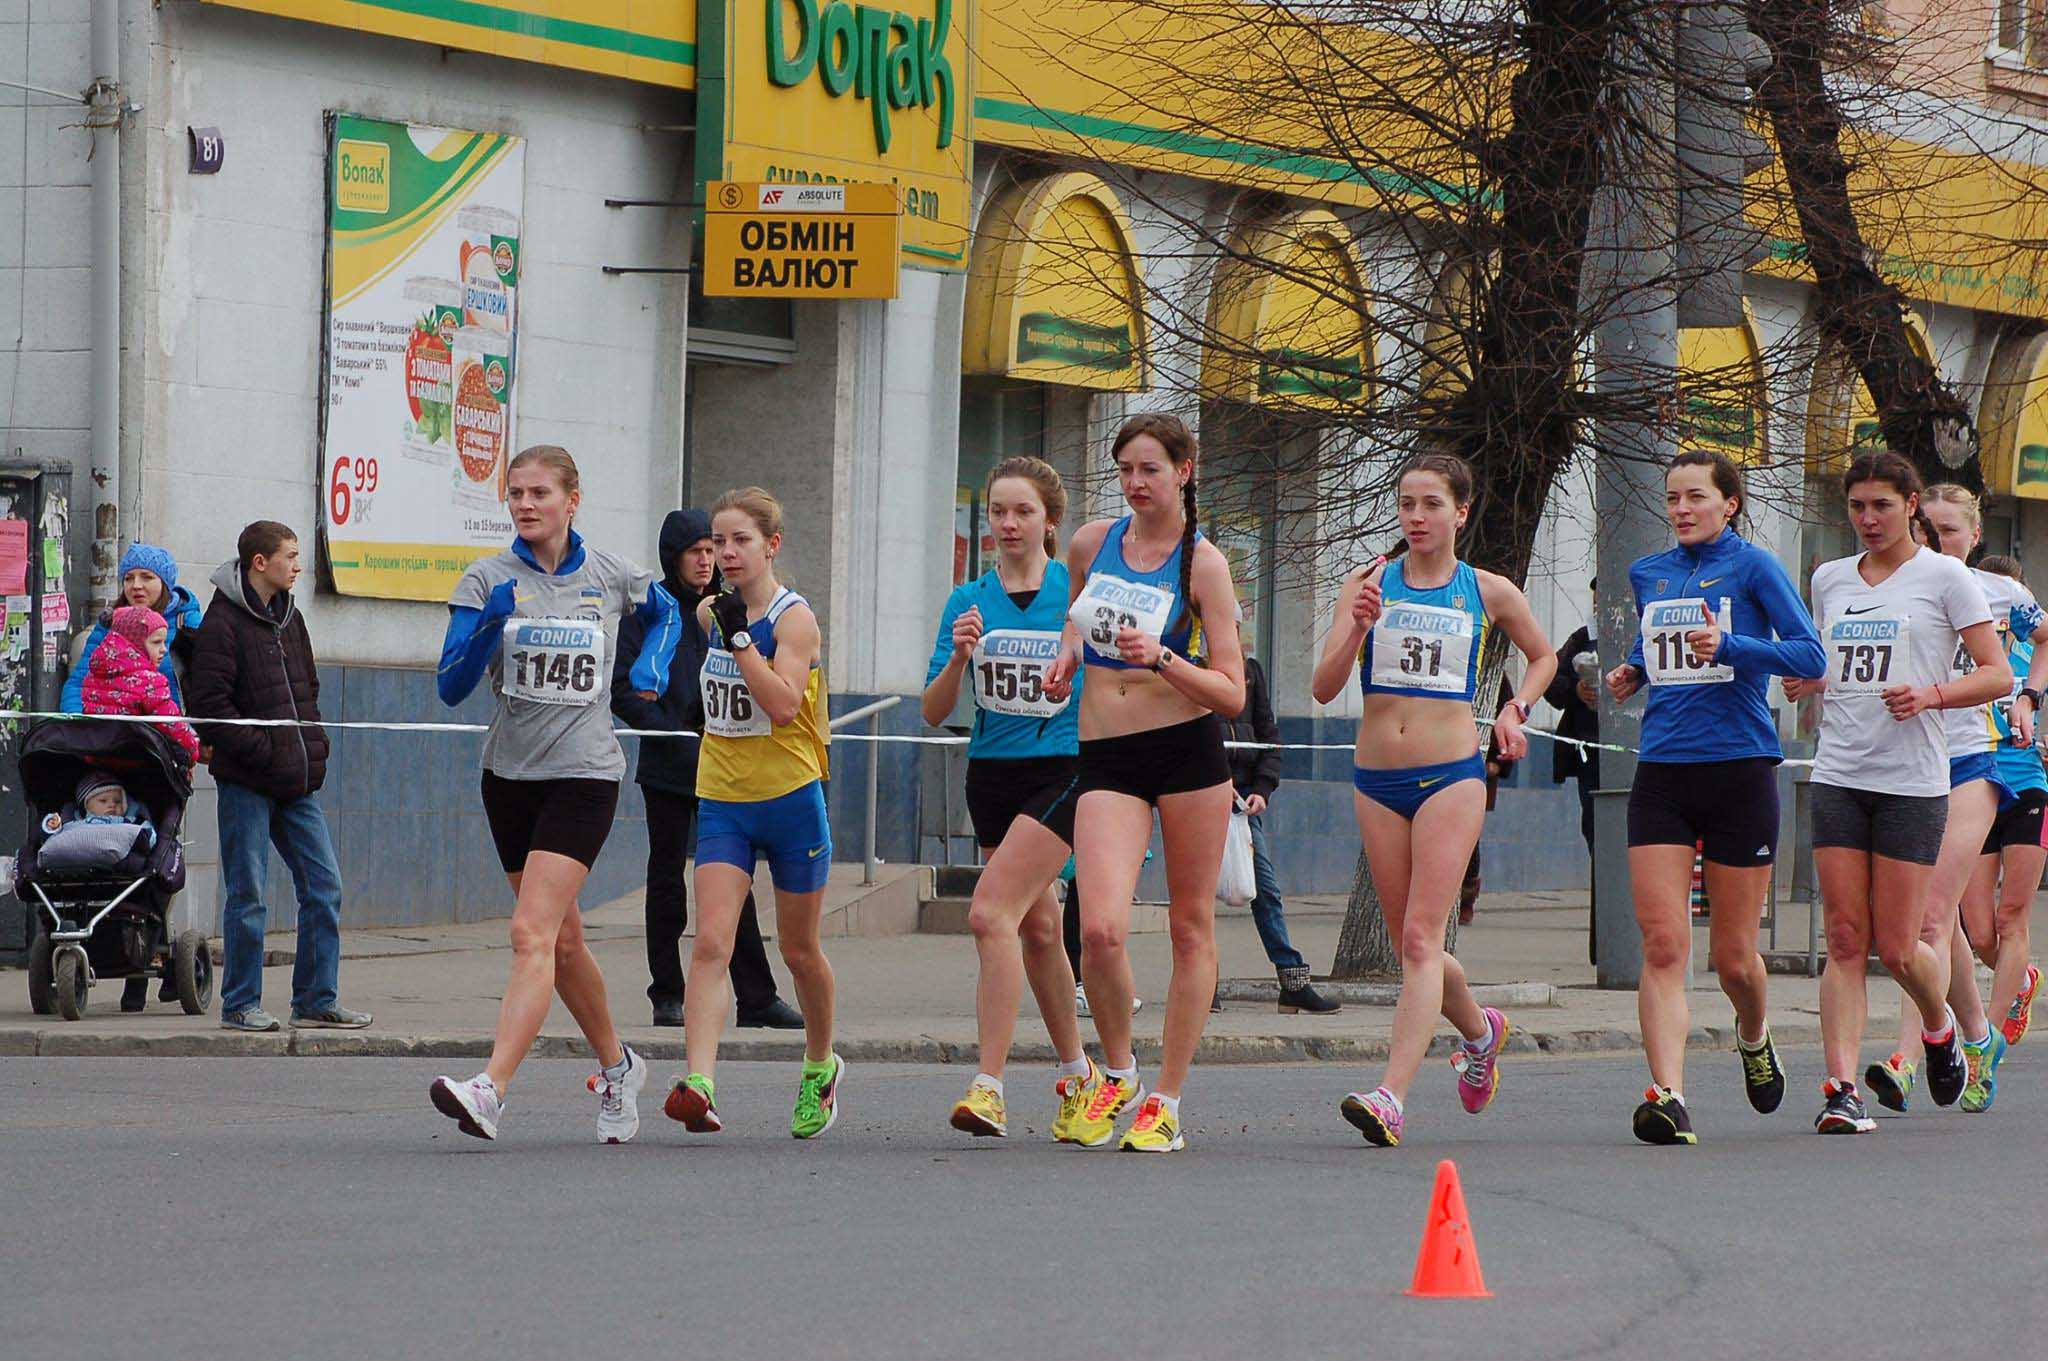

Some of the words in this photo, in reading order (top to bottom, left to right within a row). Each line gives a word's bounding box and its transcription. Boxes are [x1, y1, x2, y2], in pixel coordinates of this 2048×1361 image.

[203, 136, 219, 162] 81
[798, 190, 843, 201] ABSOLUTE
[740, 220, 854, 252] ОБМІН
[734, 257, 859, 289] ВАЛЮТ
[333, 318, 344, 332] Сир
[341, 341, 369, 351] томатами
[370, 342, 377, 351] та
[1398, 612, 1462, 633] CONICA
[1842, 622, 1896, 638] CONICA
[529, 629, 592, 646] CONICA
[996, 638, 1058, 657] CONICA
[1652, 630, 1719, 670] 113
[512, 650, 596, 692] 1146
[1400, 636, 1442, 677] 31
[1837, 645, 1892, 683] 737
[978, 661, 1069, 704] 155
[706, 679, 752, 721] 376
